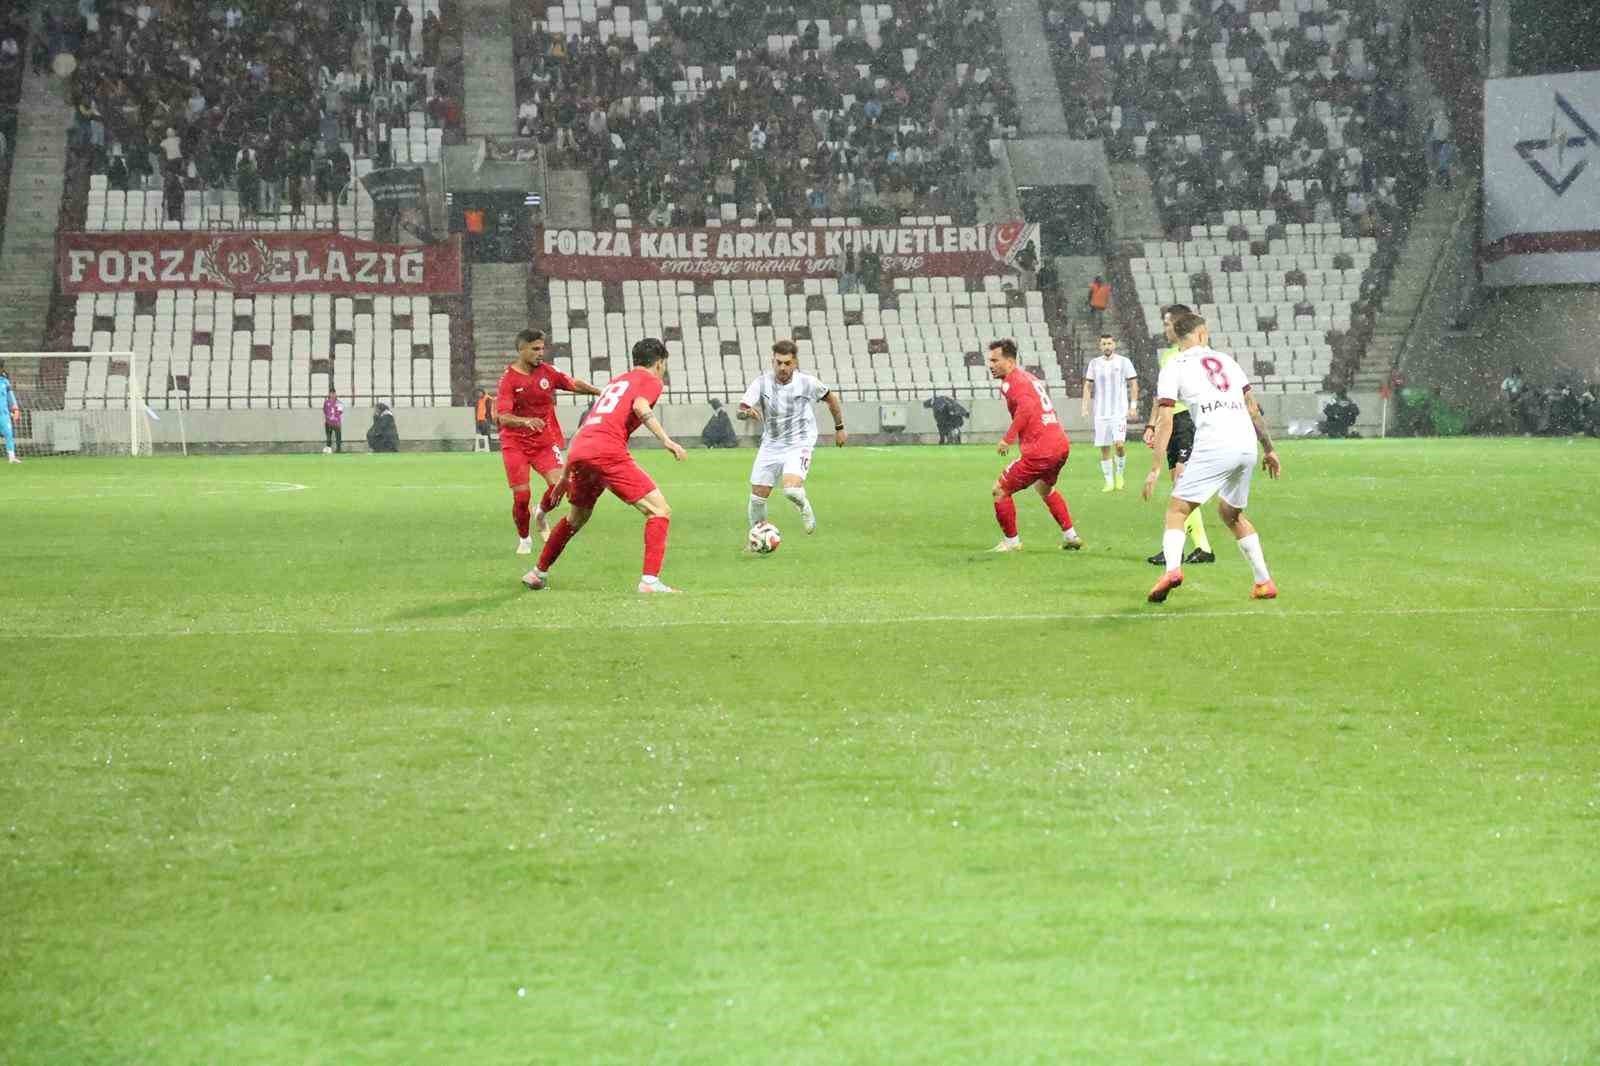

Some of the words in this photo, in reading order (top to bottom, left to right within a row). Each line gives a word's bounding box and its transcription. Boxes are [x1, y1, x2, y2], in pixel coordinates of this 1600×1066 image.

[542, 229, 632, 257] FORZA
[640, 232, 708, 257] KALE
[716, 231, 816, 257] ARKASI
[68, 249, 213, 283] FORZA
[227, 252, 249, 274] 23
[1201, 356, 1229, 392] 8
